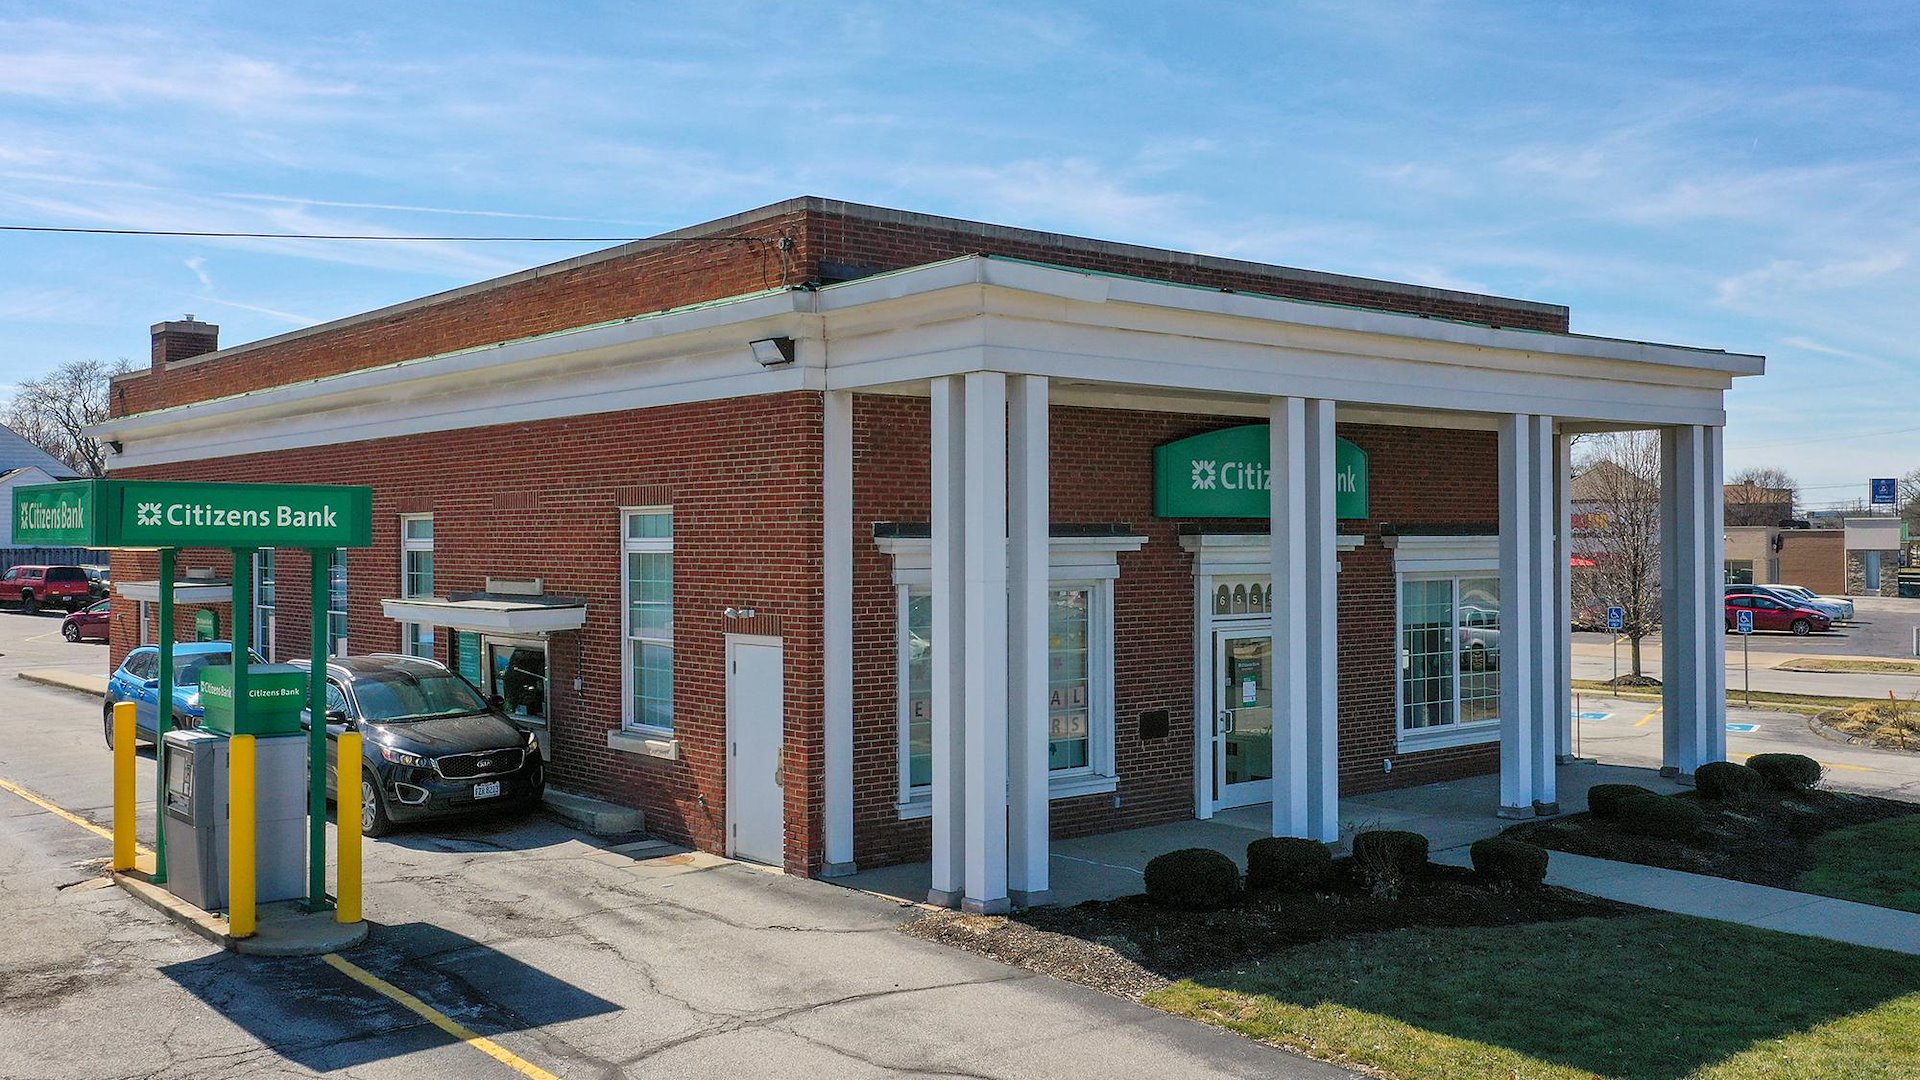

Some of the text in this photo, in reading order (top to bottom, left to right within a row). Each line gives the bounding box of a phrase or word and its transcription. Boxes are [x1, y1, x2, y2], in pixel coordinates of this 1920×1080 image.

[1220, 462, 1356, 493] Citiz nk
[29, 498, 84, 529] Citizens Bank
[167, 503, 337, 528] Citizens Bank
[249, 687, 300, 698] Citizens Bank
